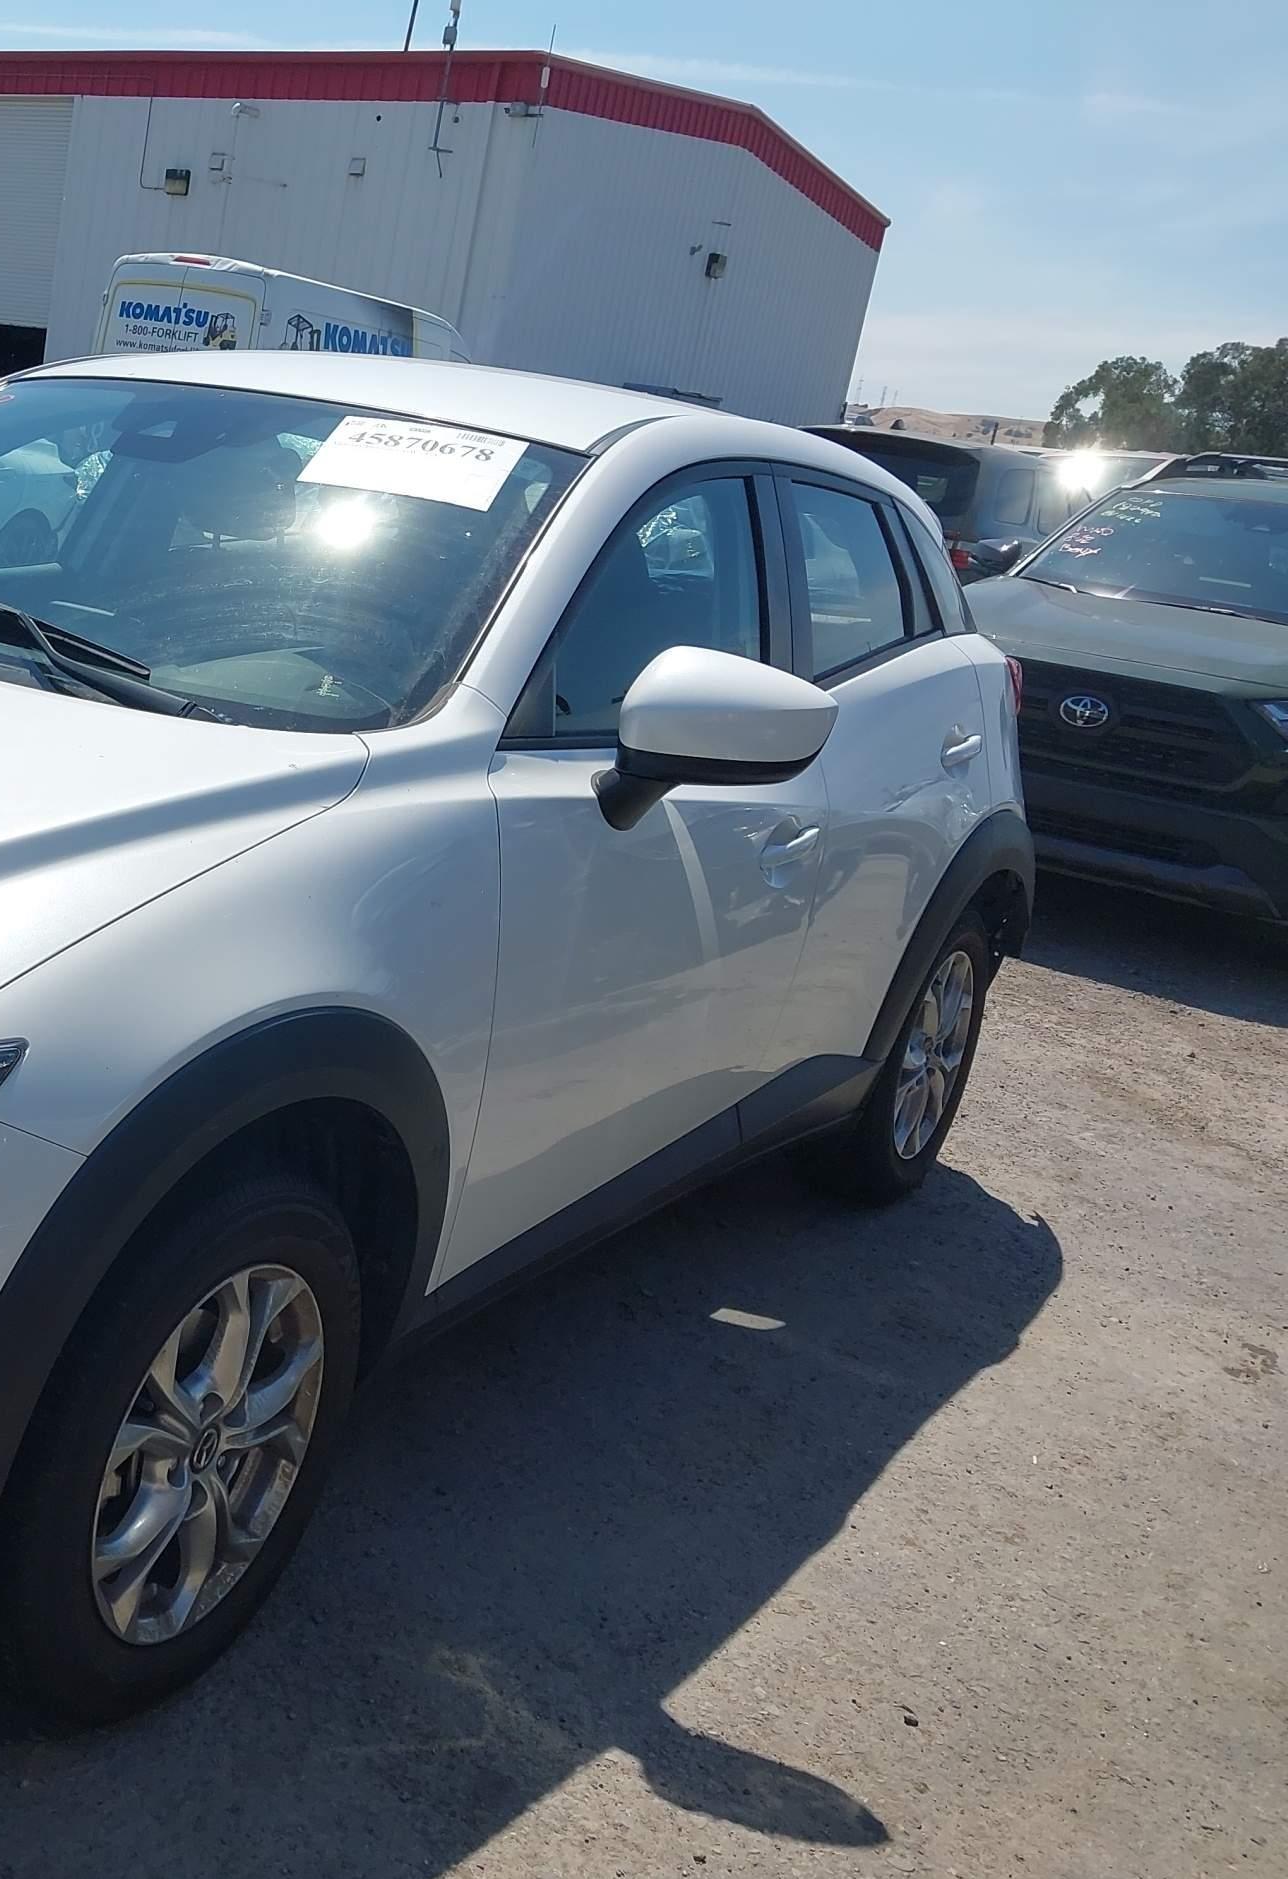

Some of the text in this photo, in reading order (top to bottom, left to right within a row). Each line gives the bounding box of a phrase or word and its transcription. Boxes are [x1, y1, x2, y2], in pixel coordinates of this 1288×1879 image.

[119, 301, 210, 328] KOMATSU
[125, 324, 199, 342] 1-800-FORKLIFT
[348, 431, 495, 462] 45870678
